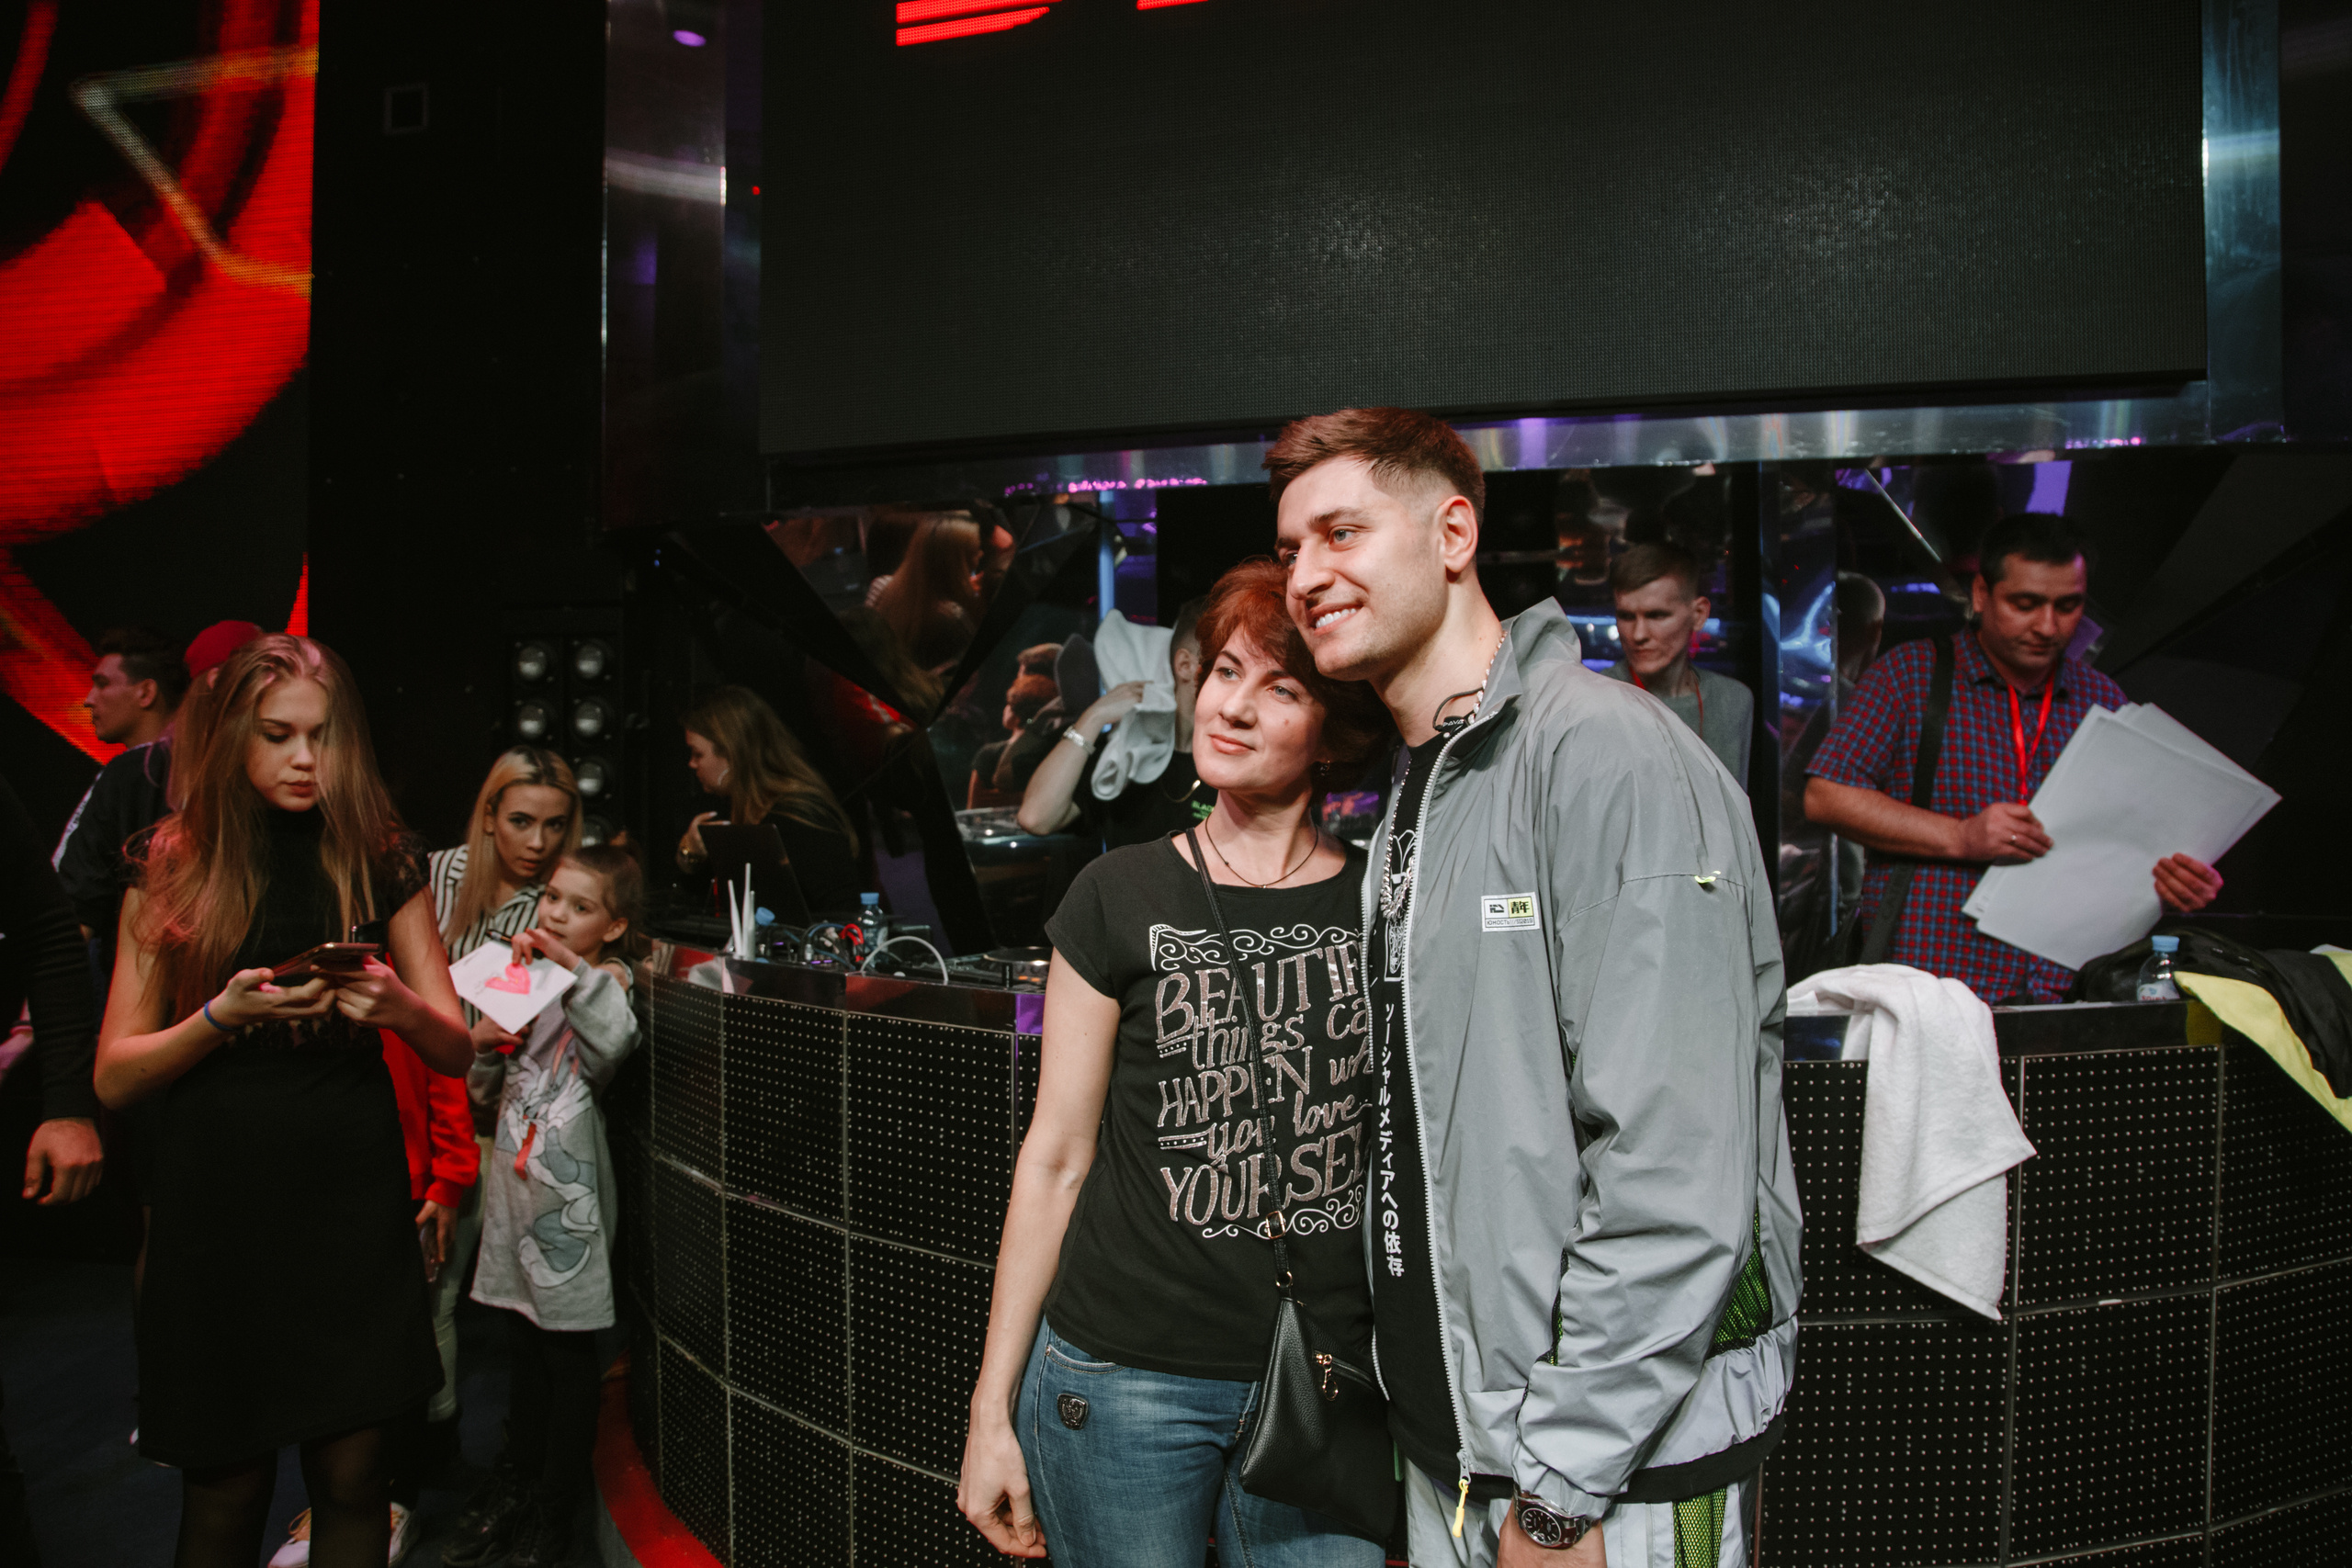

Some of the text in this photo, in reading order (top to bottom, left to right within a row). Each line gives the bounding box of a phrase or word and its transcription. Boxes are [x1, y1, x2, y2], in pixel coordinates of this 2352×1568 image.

[1206, 1090, 1372, 1167] you love
[1378, 1002, 1405, 1278] ソーシャルメディアへの依存
